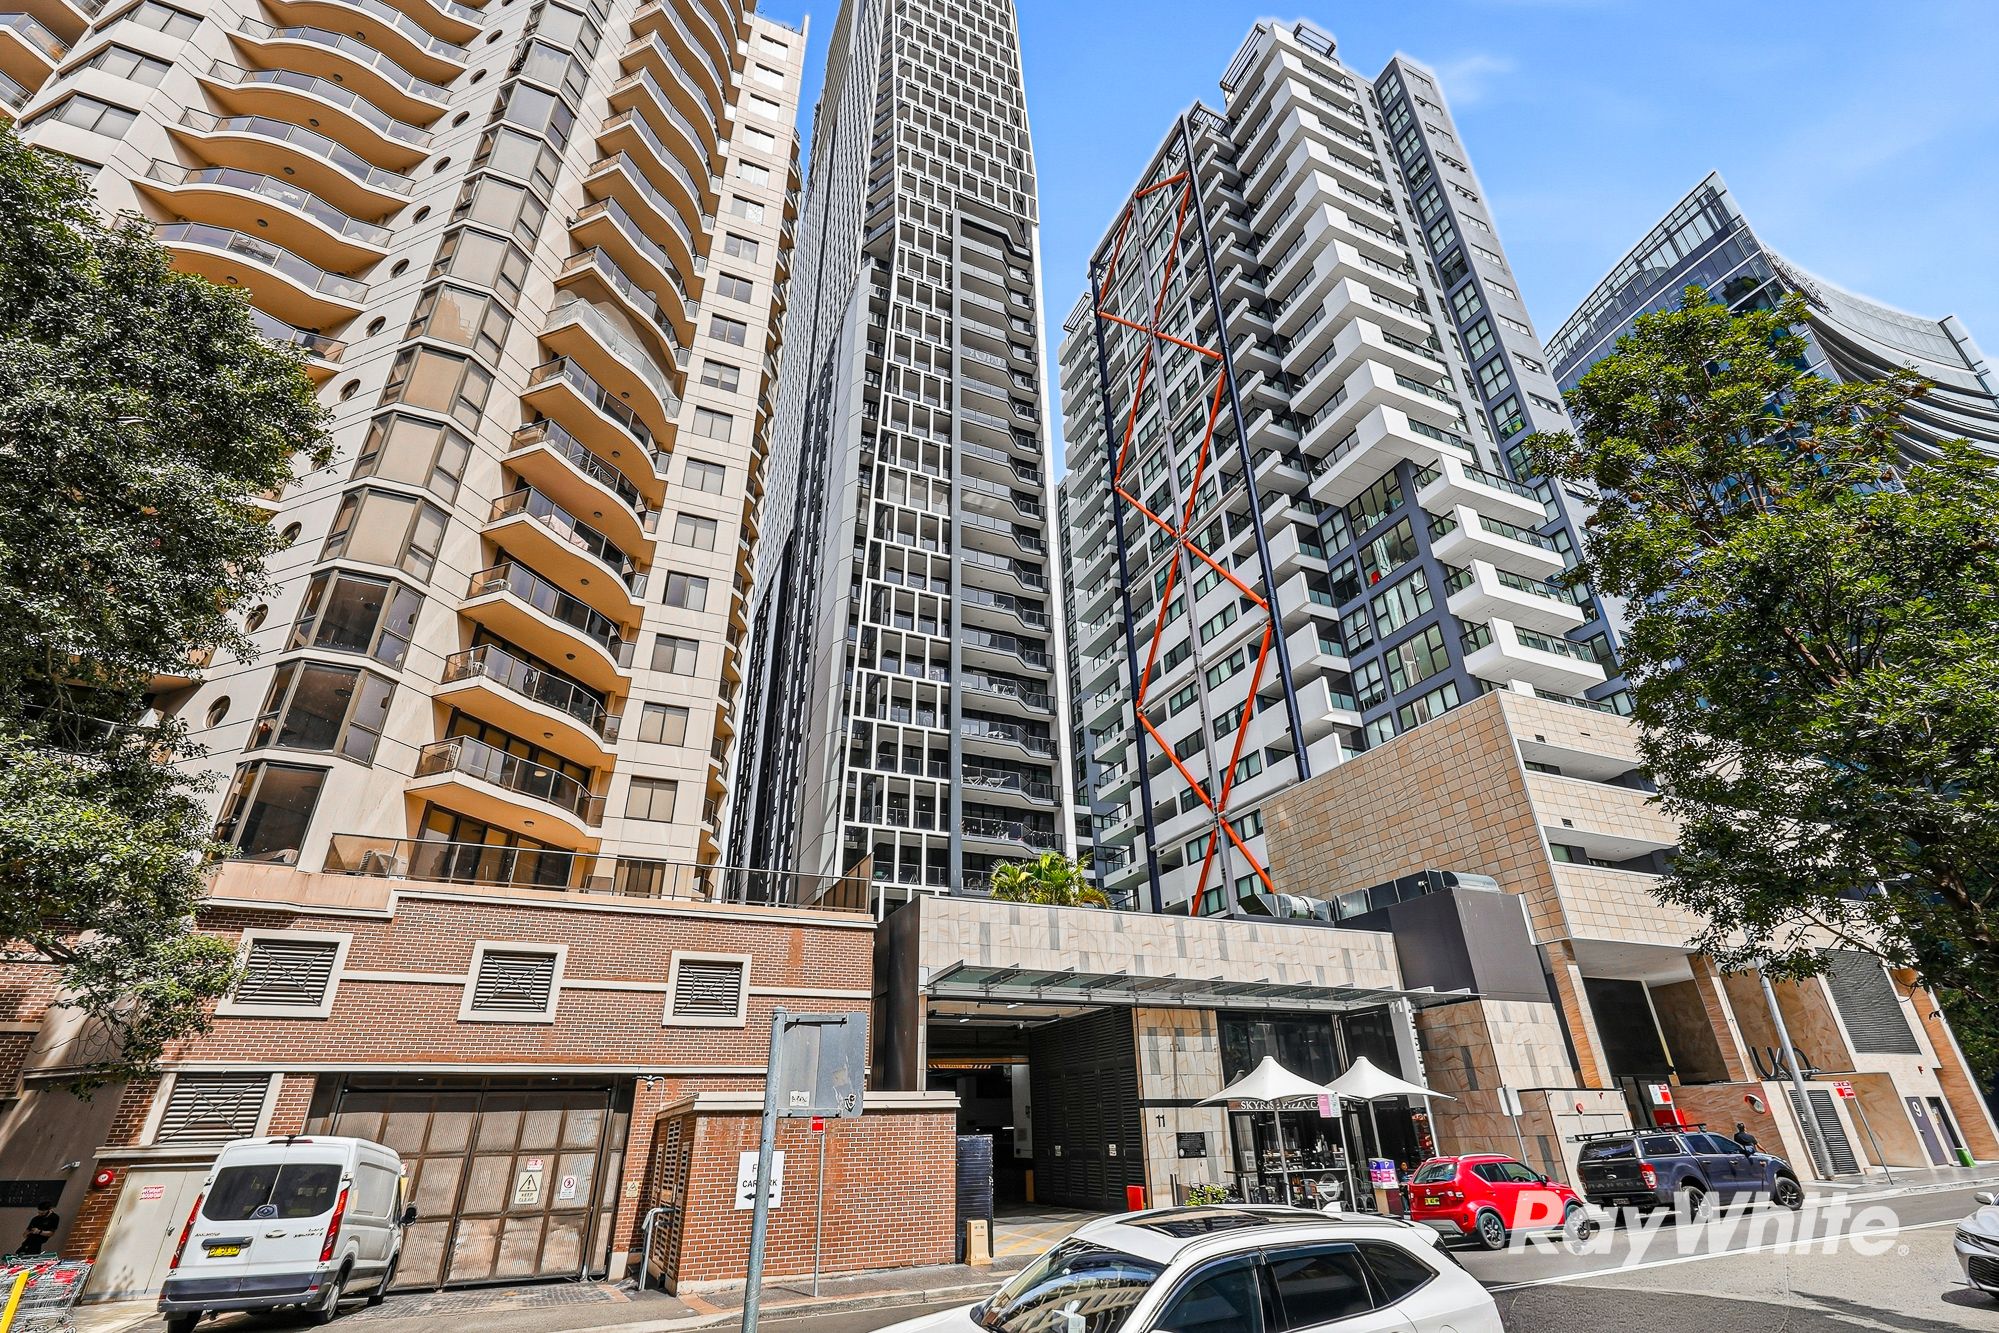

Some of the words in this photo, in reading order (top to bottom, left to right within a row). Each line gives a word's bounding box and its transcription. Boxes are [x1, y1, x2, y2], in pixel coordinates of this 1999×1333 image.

[1390, 1001, 1403, 1013] 11
[1240, 1100, 1281, 1110] SKYRIS
[1911, 1101, 1923, 1118] 9
[1155, 1114, 1166, 1128] 11
[1384, 1161, 1390, 1169] P
[742, 1179, 778, 1188] CARRK
